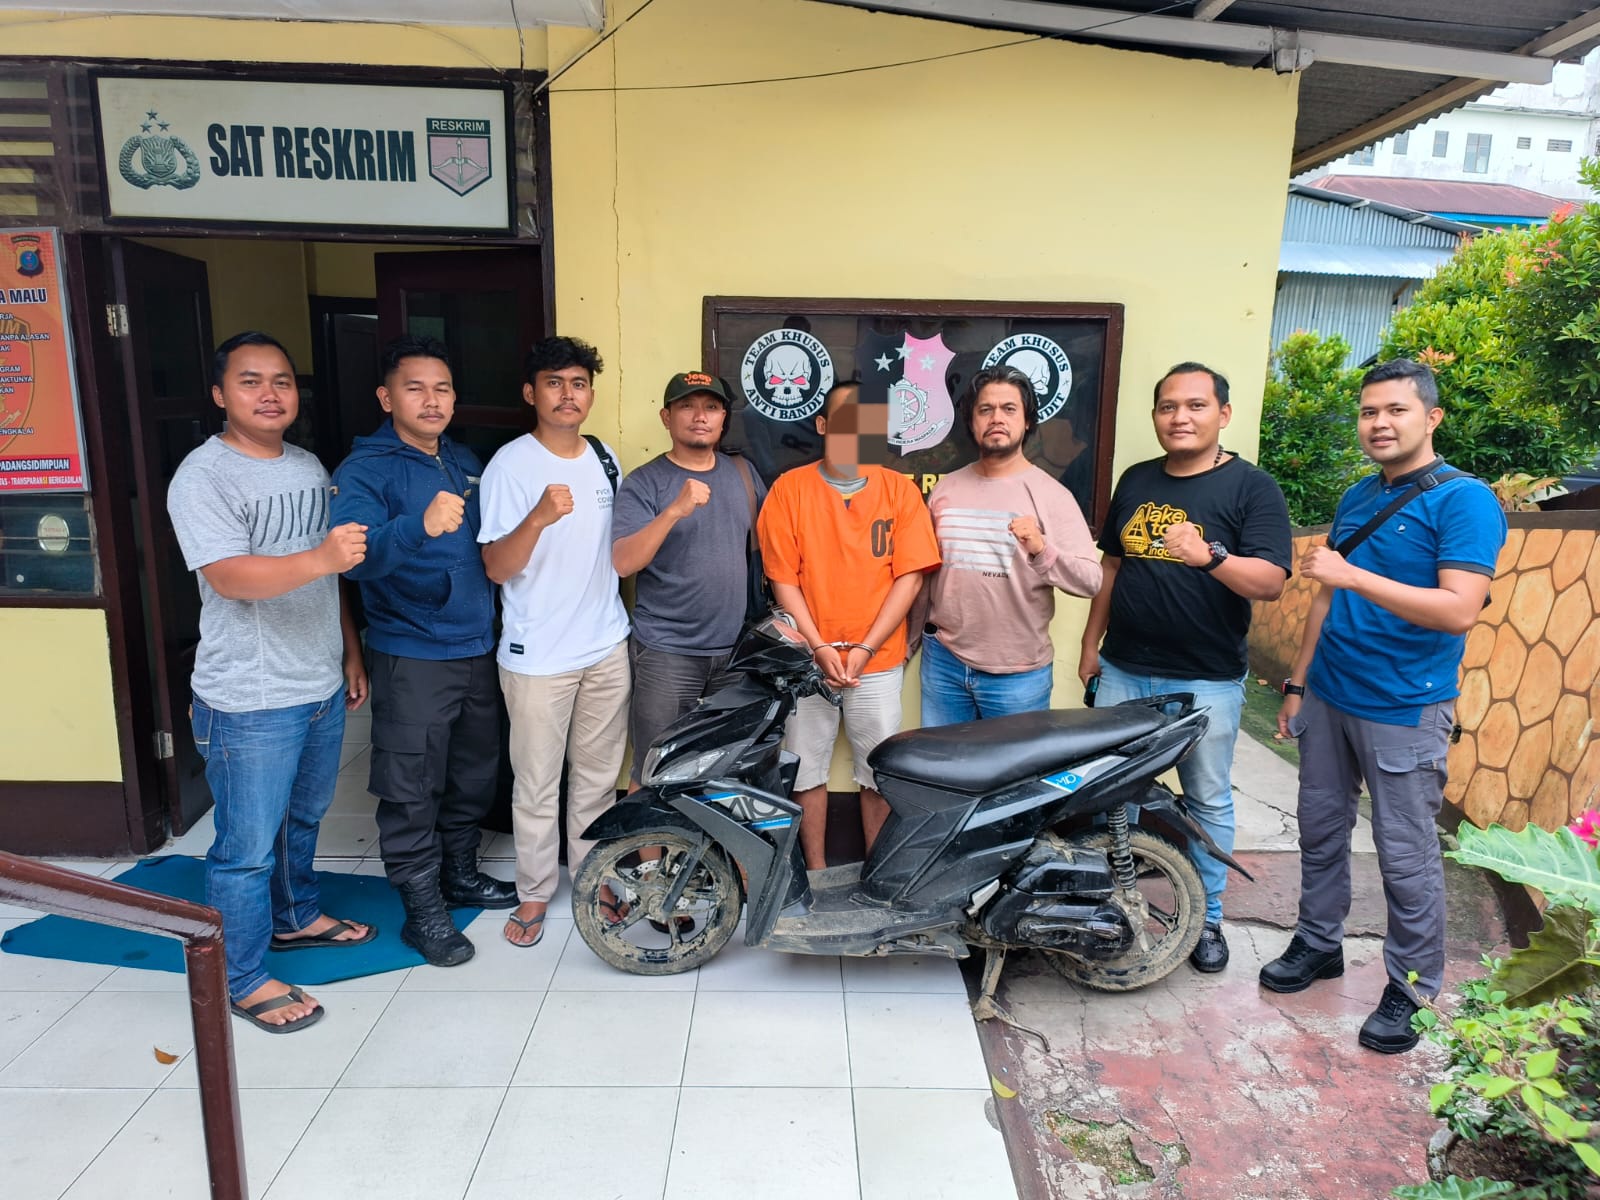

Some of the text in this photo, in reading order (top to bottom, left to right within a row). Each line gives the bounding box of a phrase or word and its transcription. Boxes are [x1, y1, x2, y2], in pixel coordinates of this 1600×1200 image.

[431, 120, 485, 132] RESKRIM
[207, 123, 417, 182] SAT RESKRIM
[9, 288, 47, 303] MALU
[745, 331, 829, 368] TEAM KHUSUS
[984, 336, 1068, 372] TEAM KHUSUS
[746, 388, 827, 419] ANTI BANDIT
[1039, 392, 1065, 420] NDIT
[1145, 504, 1184, 524] lake
[1151, 522, 1169, 536] to
[1148, 547, 1170, 557] indo
